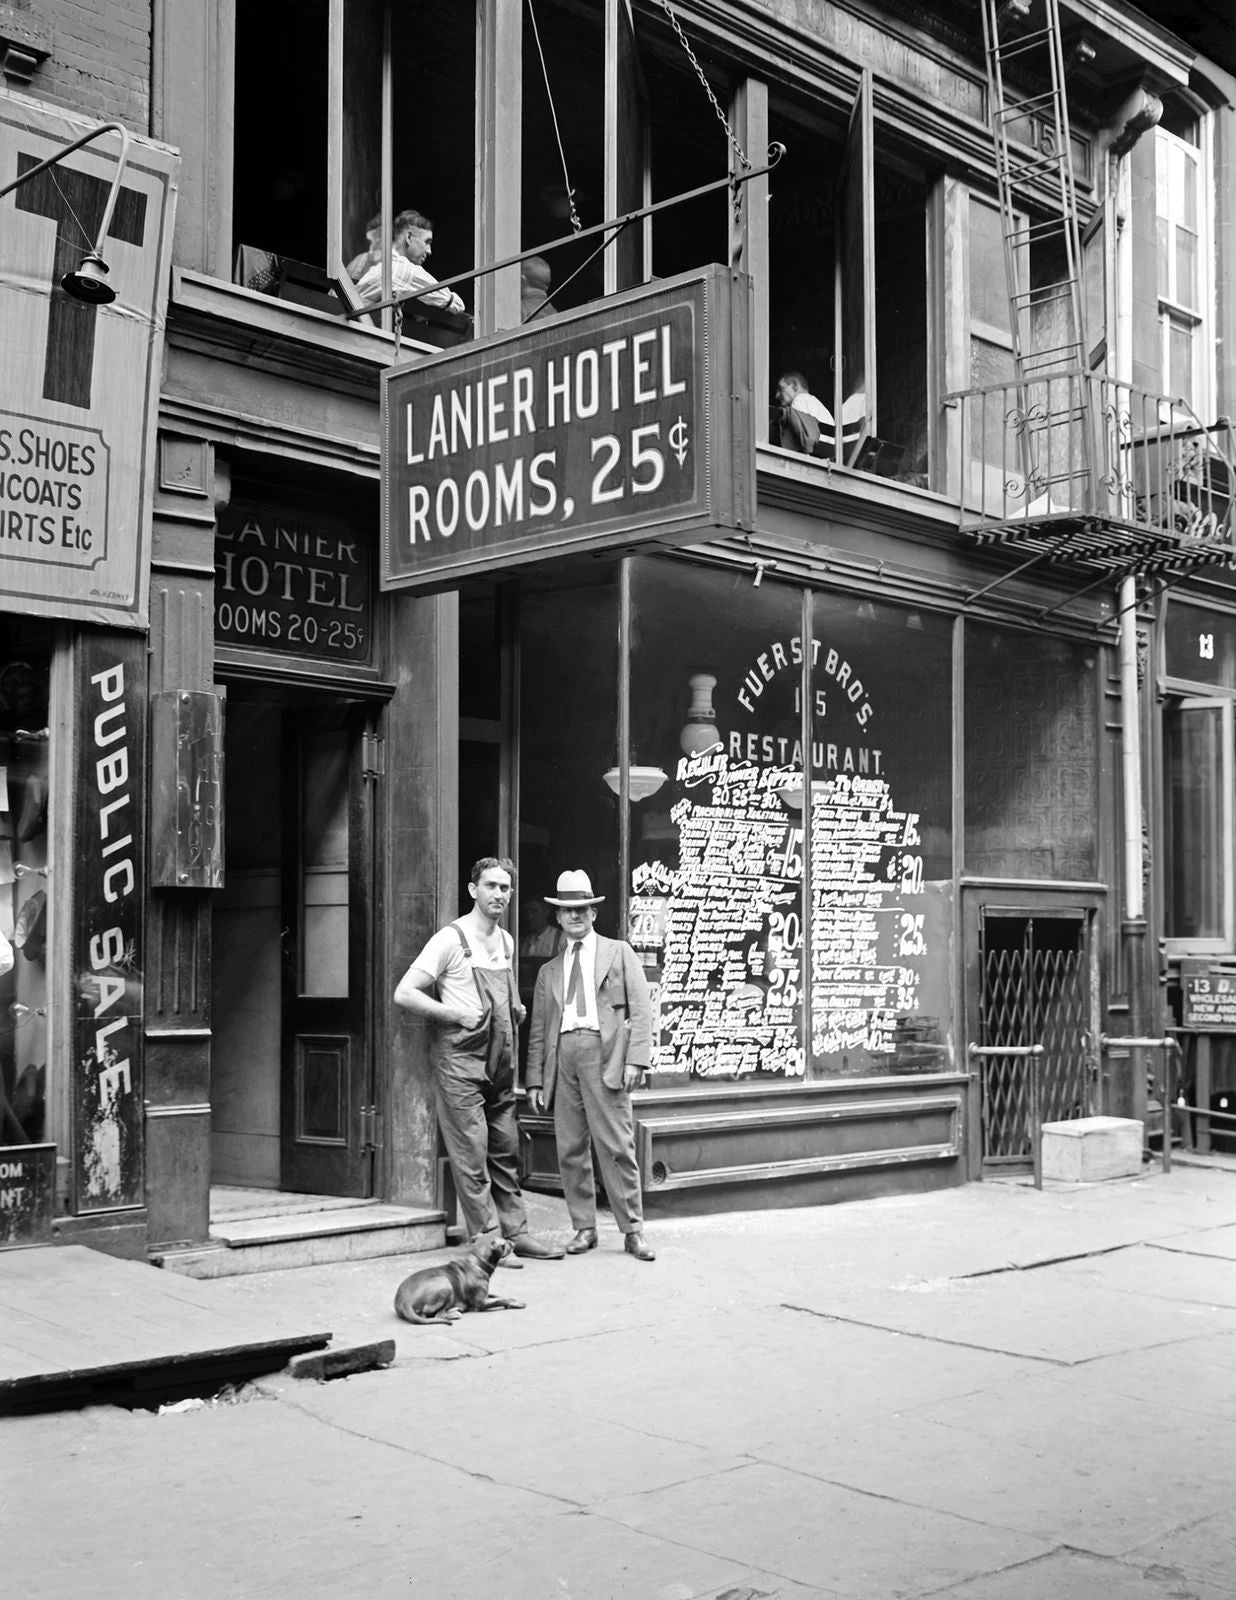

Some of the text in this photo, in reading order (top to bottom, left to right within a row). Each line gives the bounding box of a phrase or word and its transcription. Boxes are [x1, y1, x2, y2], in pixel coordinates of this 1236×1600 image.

[407, 324, 687, 465] LANIER HOTEL
[408, 450, 575, 545] ROOMS,
[216, 602, 281, 638] OOMS
[90, 662, 135, 904] PUBLIC
[90, 933, 133, 1111] SALE
